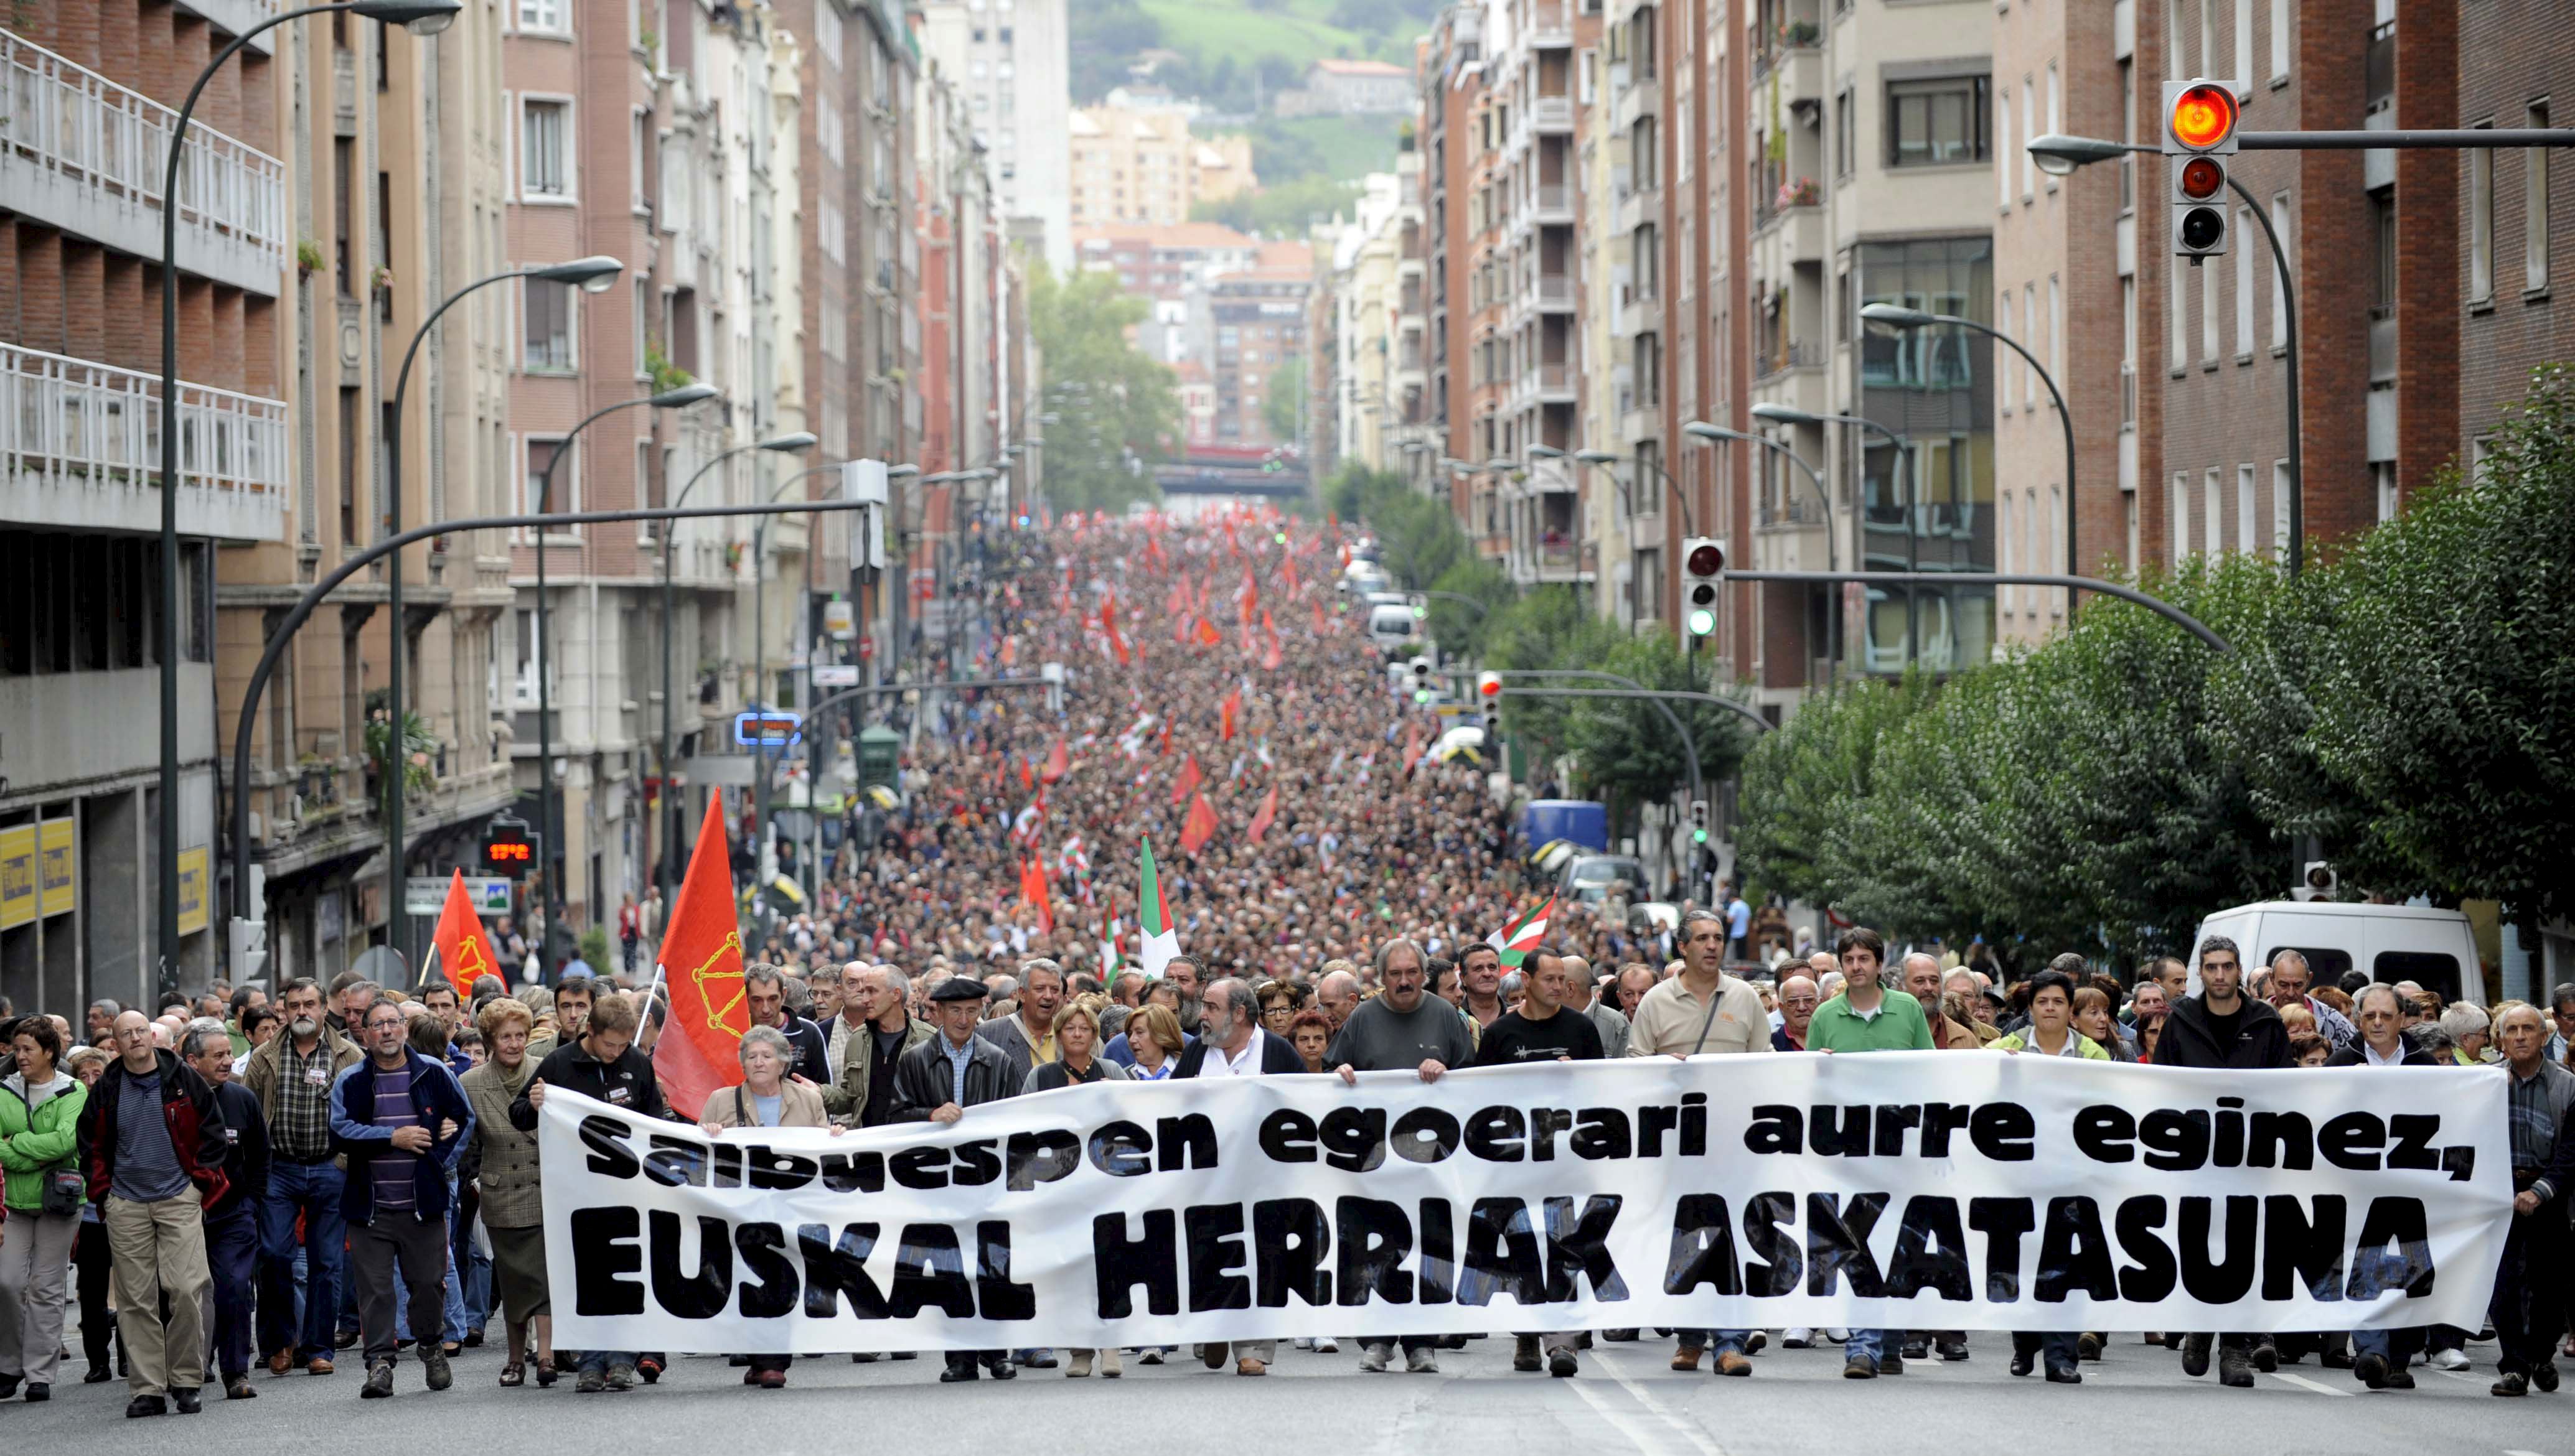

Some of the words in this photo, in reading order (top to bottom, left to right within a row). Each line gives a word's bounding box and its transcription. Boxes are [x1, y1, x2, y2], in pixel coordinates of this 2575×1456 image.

[578, 1113, 1219, 1193] Salbuespen
[1258, 1092, 1707, 1174] egoerari
[1743, 1101, 2035, 1162] aurre
[2072, 1096, 2475, 1182] eginez,
[570, 1205, 1036, 1320] EUSKAL
[1092, 1193, 1630, 1320] HERRIAK
[1663, 1191, 2436, 1305] ASKATASUNA
